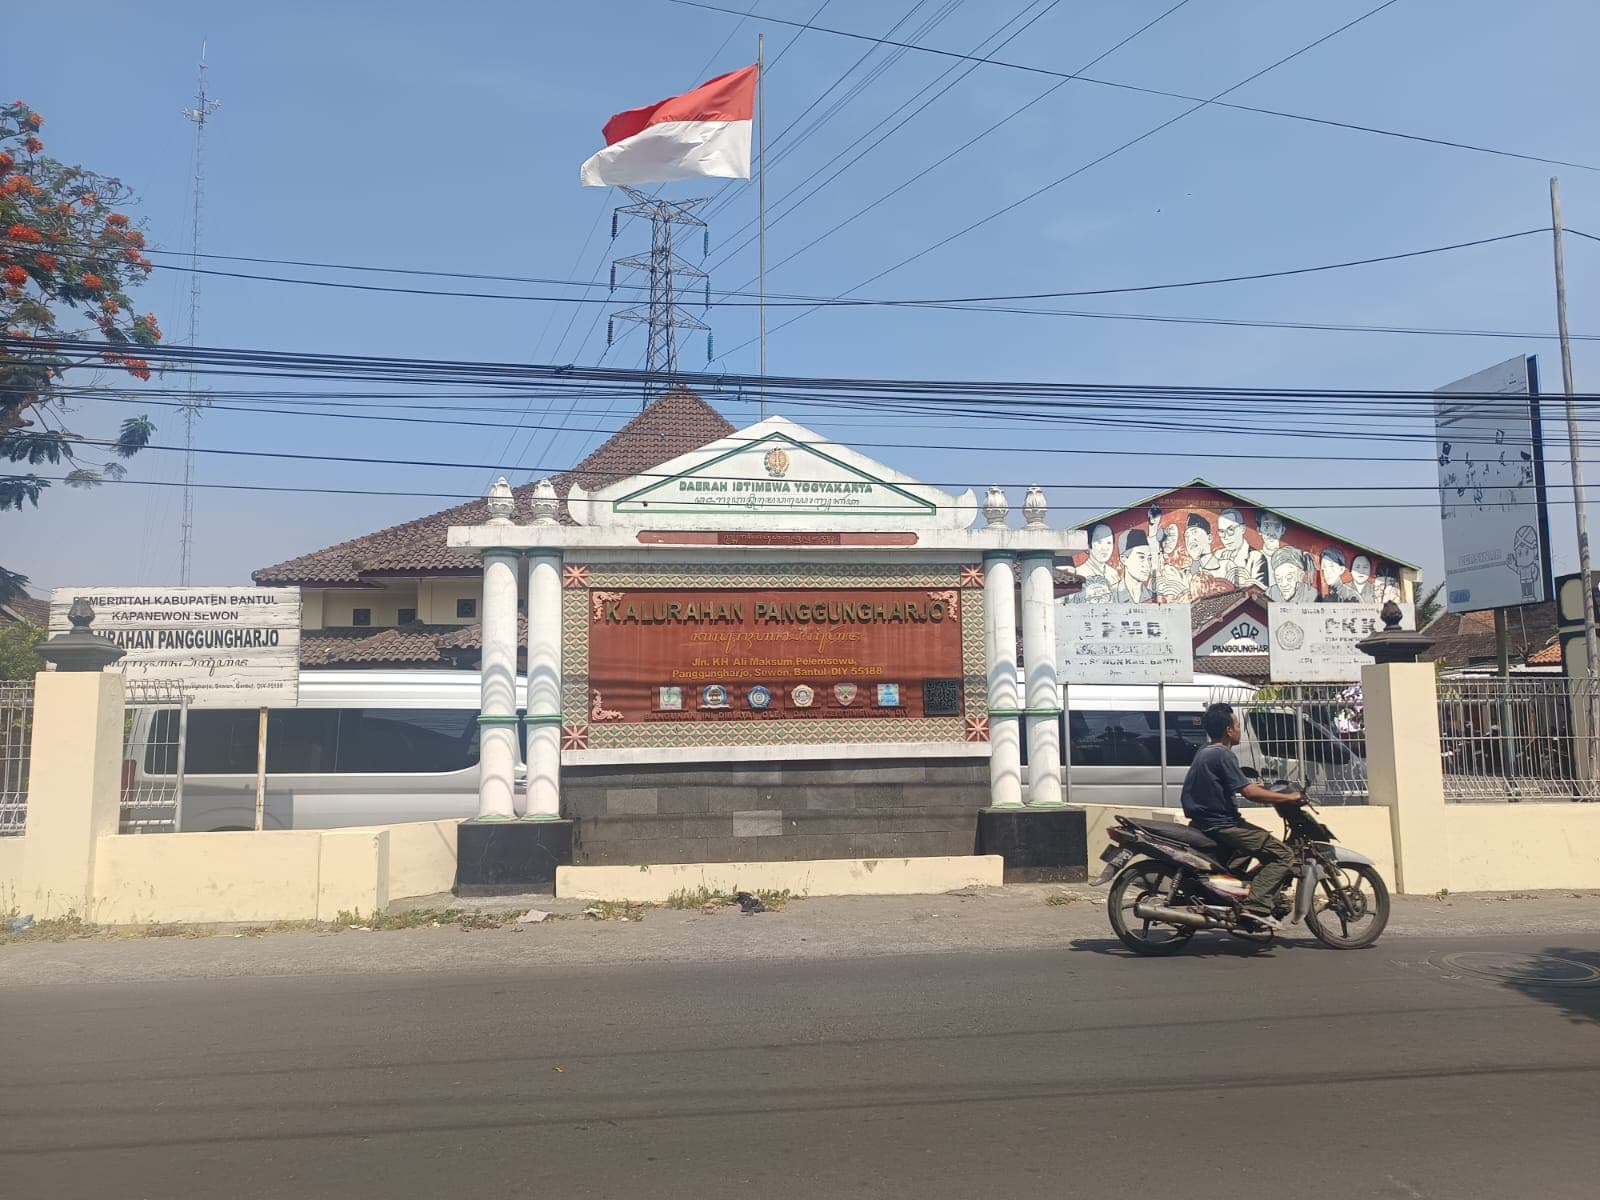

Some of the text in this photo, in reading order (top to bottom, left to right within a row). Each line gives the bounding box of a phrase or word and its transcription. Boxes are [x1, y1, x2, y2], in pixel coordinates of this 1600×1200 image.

[679, 481, 873, 494] DAERAH ISTIMEWA YOGYAKARTA
[73, 595, 279, 606] MERINTAH KABUPATEN BANTUL
[112, 611, 239, 620] KAPANEWON SEWON
[605, 600, 946, 624] KALURAHAN PANGGUNGHARJO
[1231, 622, 1260, 640] GOR
[158, 629, 279, 649] PANGGUNGHARJO
[691, 657, 710, 666] Jln.
[712, 657, 728, 666] KH
[733, 657, 747, 666] Ali
[831, 666, 848, 676] DIY
[851, 666, 882, 675] 55188
